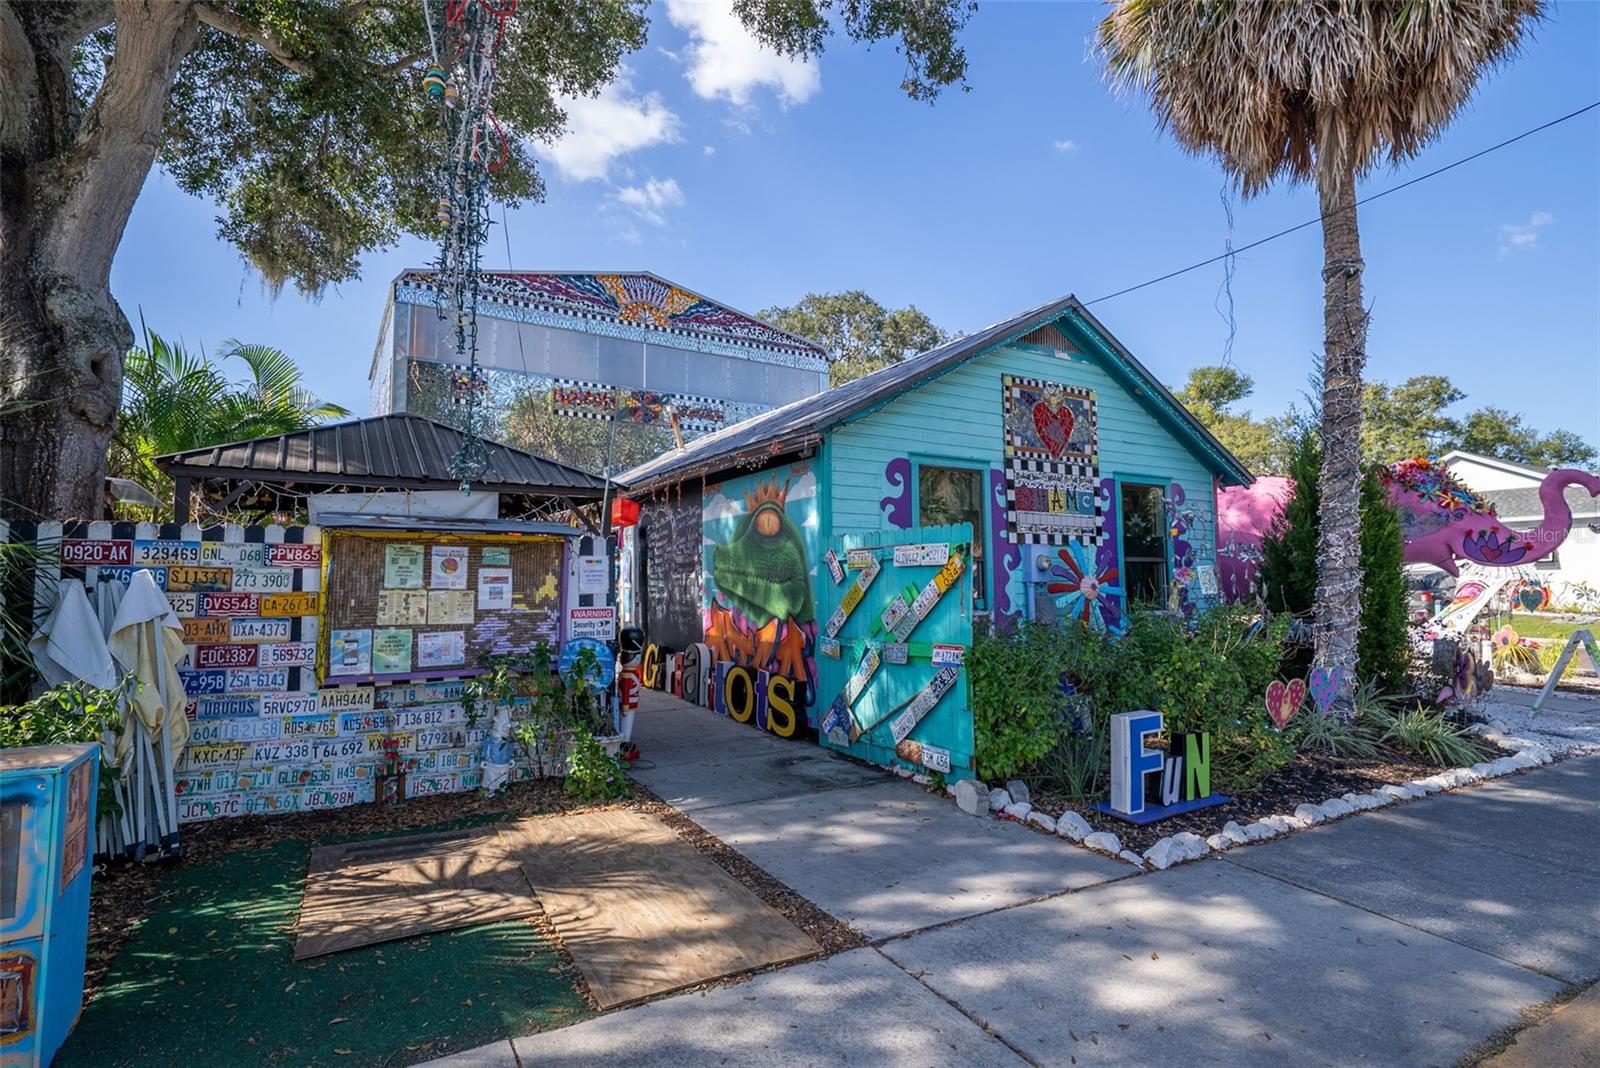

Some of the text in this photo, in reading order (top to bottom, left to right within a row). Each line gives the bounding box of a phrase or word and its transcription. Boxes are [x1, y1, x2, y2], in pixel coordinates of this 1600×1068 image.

[141, 546, 198, 561] 329469
[203, 548, 225, 561] GNL
[269, 548, 319, 561] PPW865
[234, 573, 257, 588] 273
[203, 598, 258, 610] DVS548
[573, 609, 612, 618] WARNING
[573, 620, 596, 629] Security
[573, 629, 596, 637] Cameras
[229, 674, 285, 688] ZSA-6143
[204, 700, 255, 716] UBUGUS
[263, 699, 316, 715] 5RVC970
[320, 692, 371, 709] AAH9444
[404, 713, 422, 727] 136
[424, 711, 443, 724] 812
[193, 725, 218, 741] 604
[255, 744, 309, 762] KVZ 338
[323, 744, 338, 758] 64
[341, 741, 364, 756] 692
